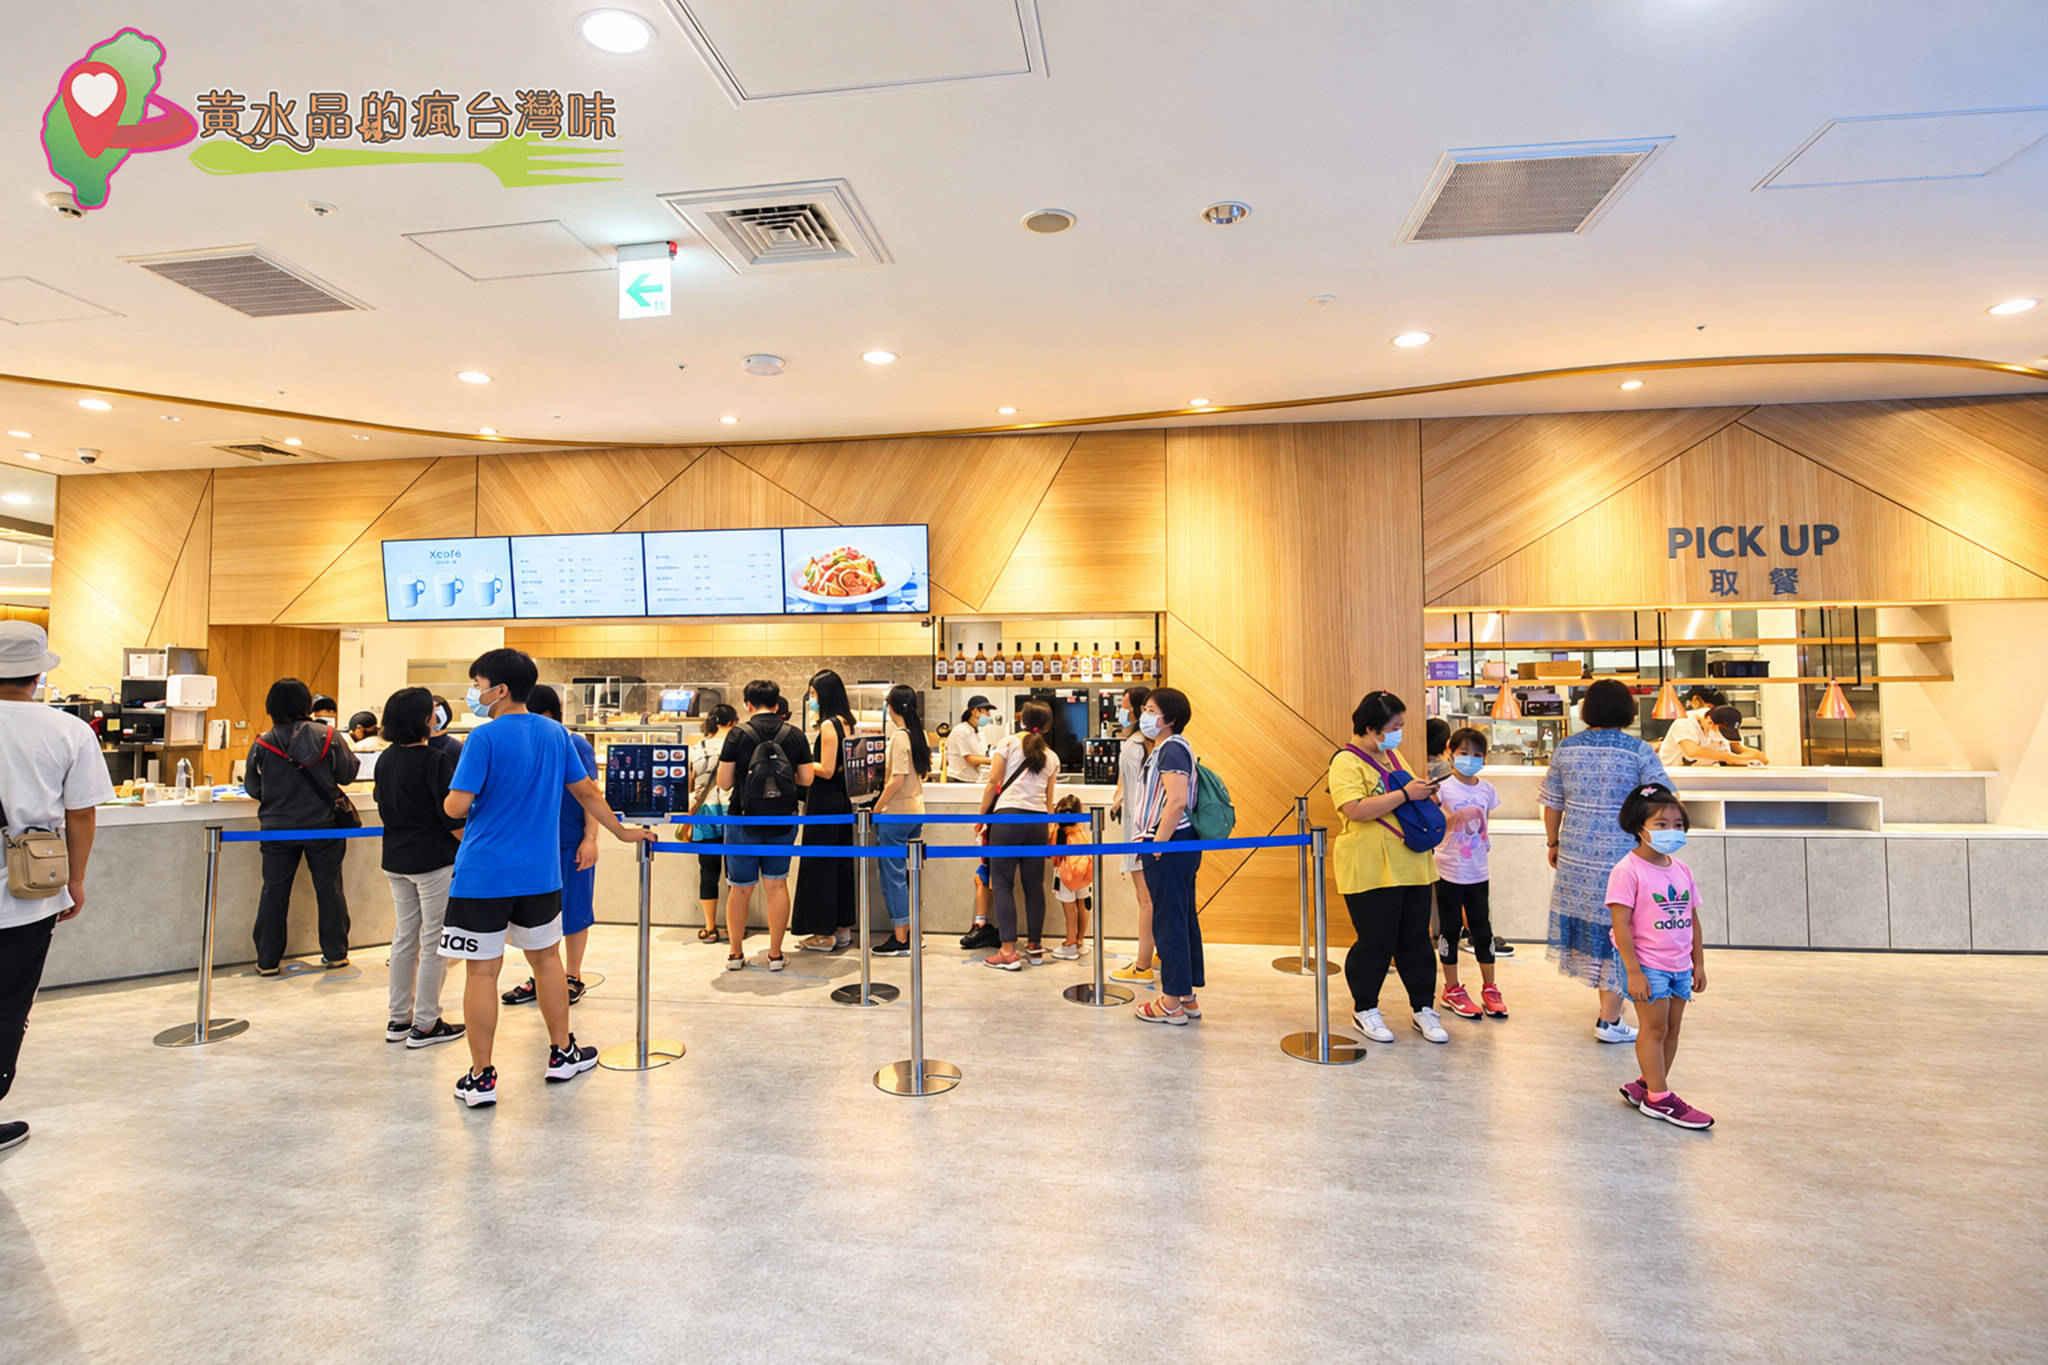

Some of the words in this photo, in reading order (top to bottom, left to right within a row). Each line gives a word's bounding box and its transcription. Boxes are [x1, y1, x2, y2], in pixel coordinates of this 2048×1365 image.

[1668, 525, 1767, 559] PICK
[1779, 523, 1840, 557] UP
[1709, 567, 1799, 597] 取餐
